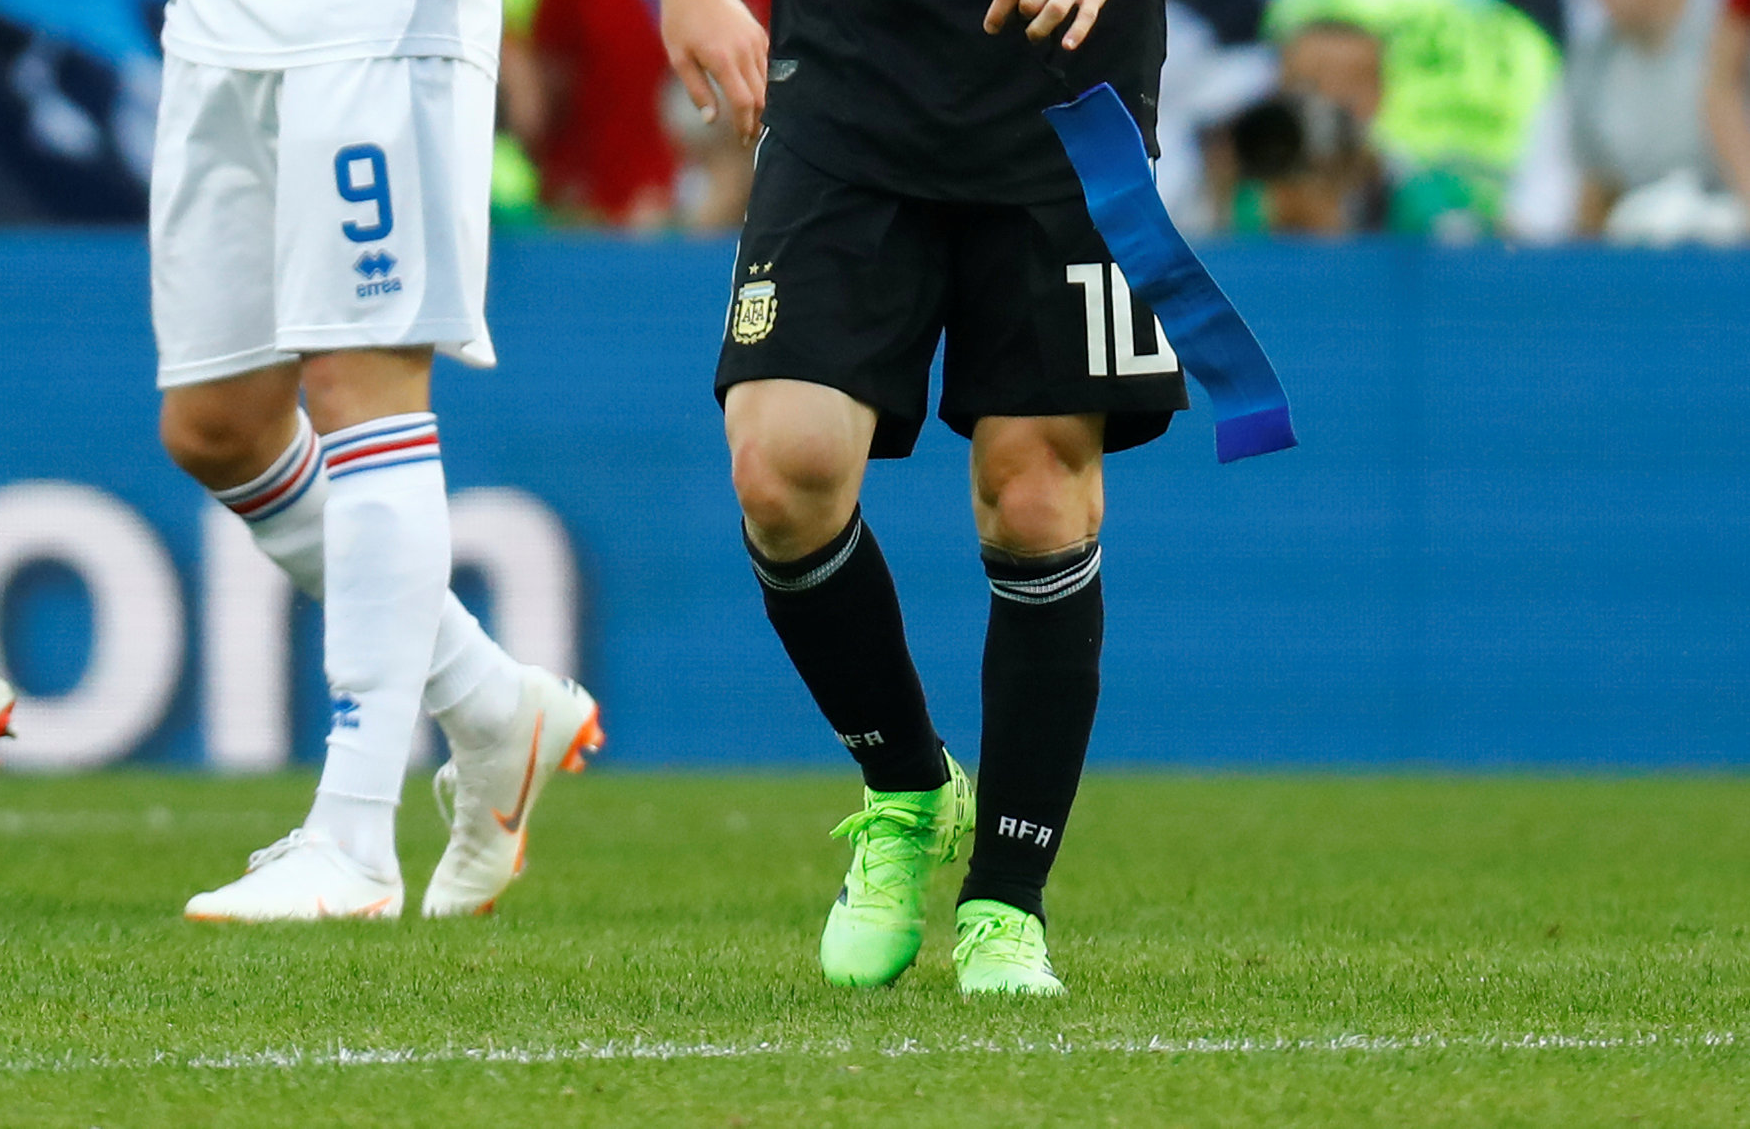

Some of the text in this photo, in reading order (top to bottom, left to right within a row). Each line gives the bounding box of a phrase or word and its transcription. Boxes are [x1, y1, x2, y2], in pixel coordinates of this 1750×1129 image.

[335, 142, 393, 243] 9
[1066, 262, 1179, 376] 10
[998, 815, 1053, 848] AFA
